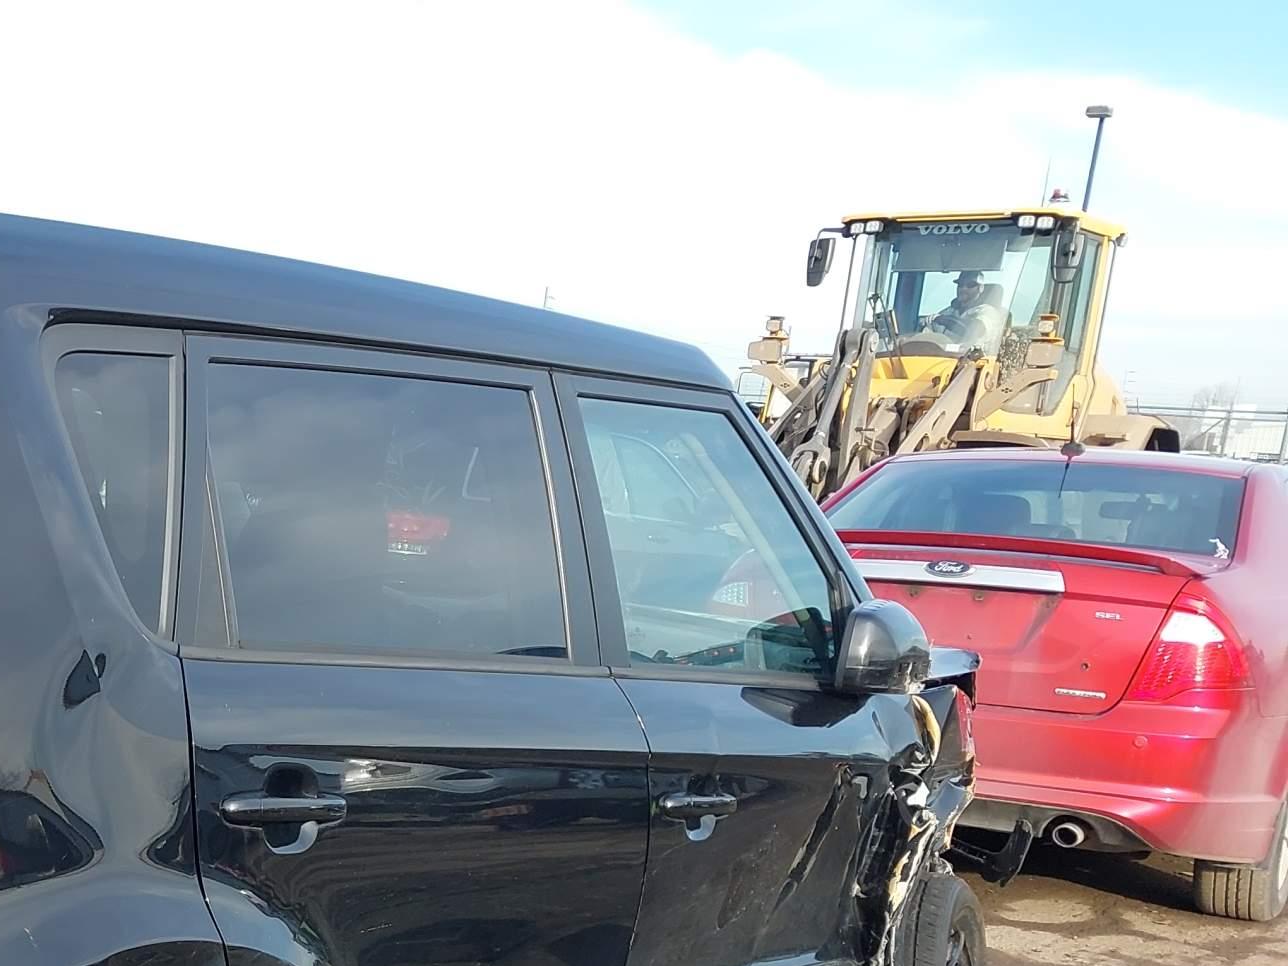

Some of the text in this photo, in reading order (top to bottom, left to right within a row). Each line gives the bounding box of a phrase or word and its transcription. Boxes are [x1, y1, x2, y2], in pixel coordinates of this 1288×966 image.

[917, 223, 991, 237] VOLVO
[933, 561, 964, 573] Ford
[1095, 611, 1123, 621] SEL
